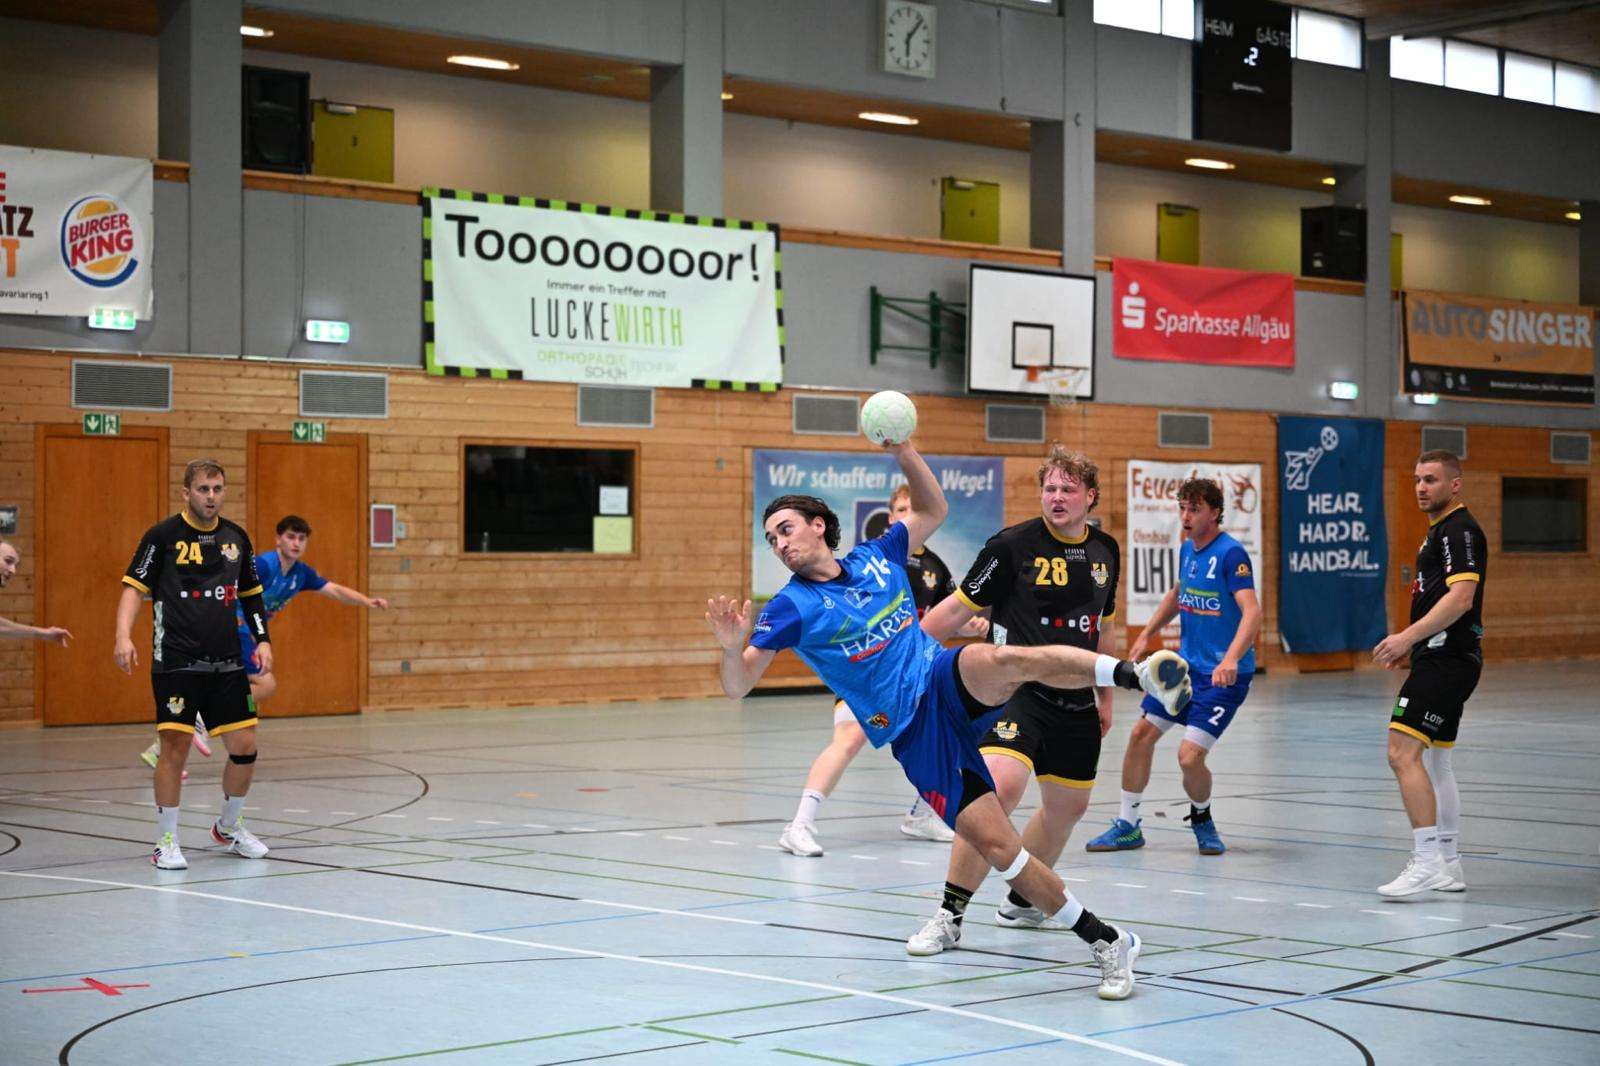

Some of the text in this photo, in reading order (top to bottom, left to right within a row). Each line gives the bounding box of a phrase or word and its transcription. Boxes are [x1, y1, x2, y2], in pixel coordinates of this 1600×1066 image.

[1205, 17, 1234, 38] HEIM
[68, 213, 130, 243] BURGER
[70, 229, 134, 268] KING
[44, 290, 49, 300] 1
[547, 279, 667, 299] Immer ein Treffer mit
[1154, 307, 1290, 344] Sparkasse Allgäu
[768, 464, 806, 488] Wir
[810, 465, 886, 489] schaffen
[941, 468, 994, 498] Wege!
[1307, 491, 1363, 515] HEAR.
[175, 540, 204, 565] 24
[1034, 556, 1069, 587] 28
[1205, 556, 1218, 579] 2
[1177, 593, 1221, 611] ARTIG
[1208, 706, 1226, 726] 2
